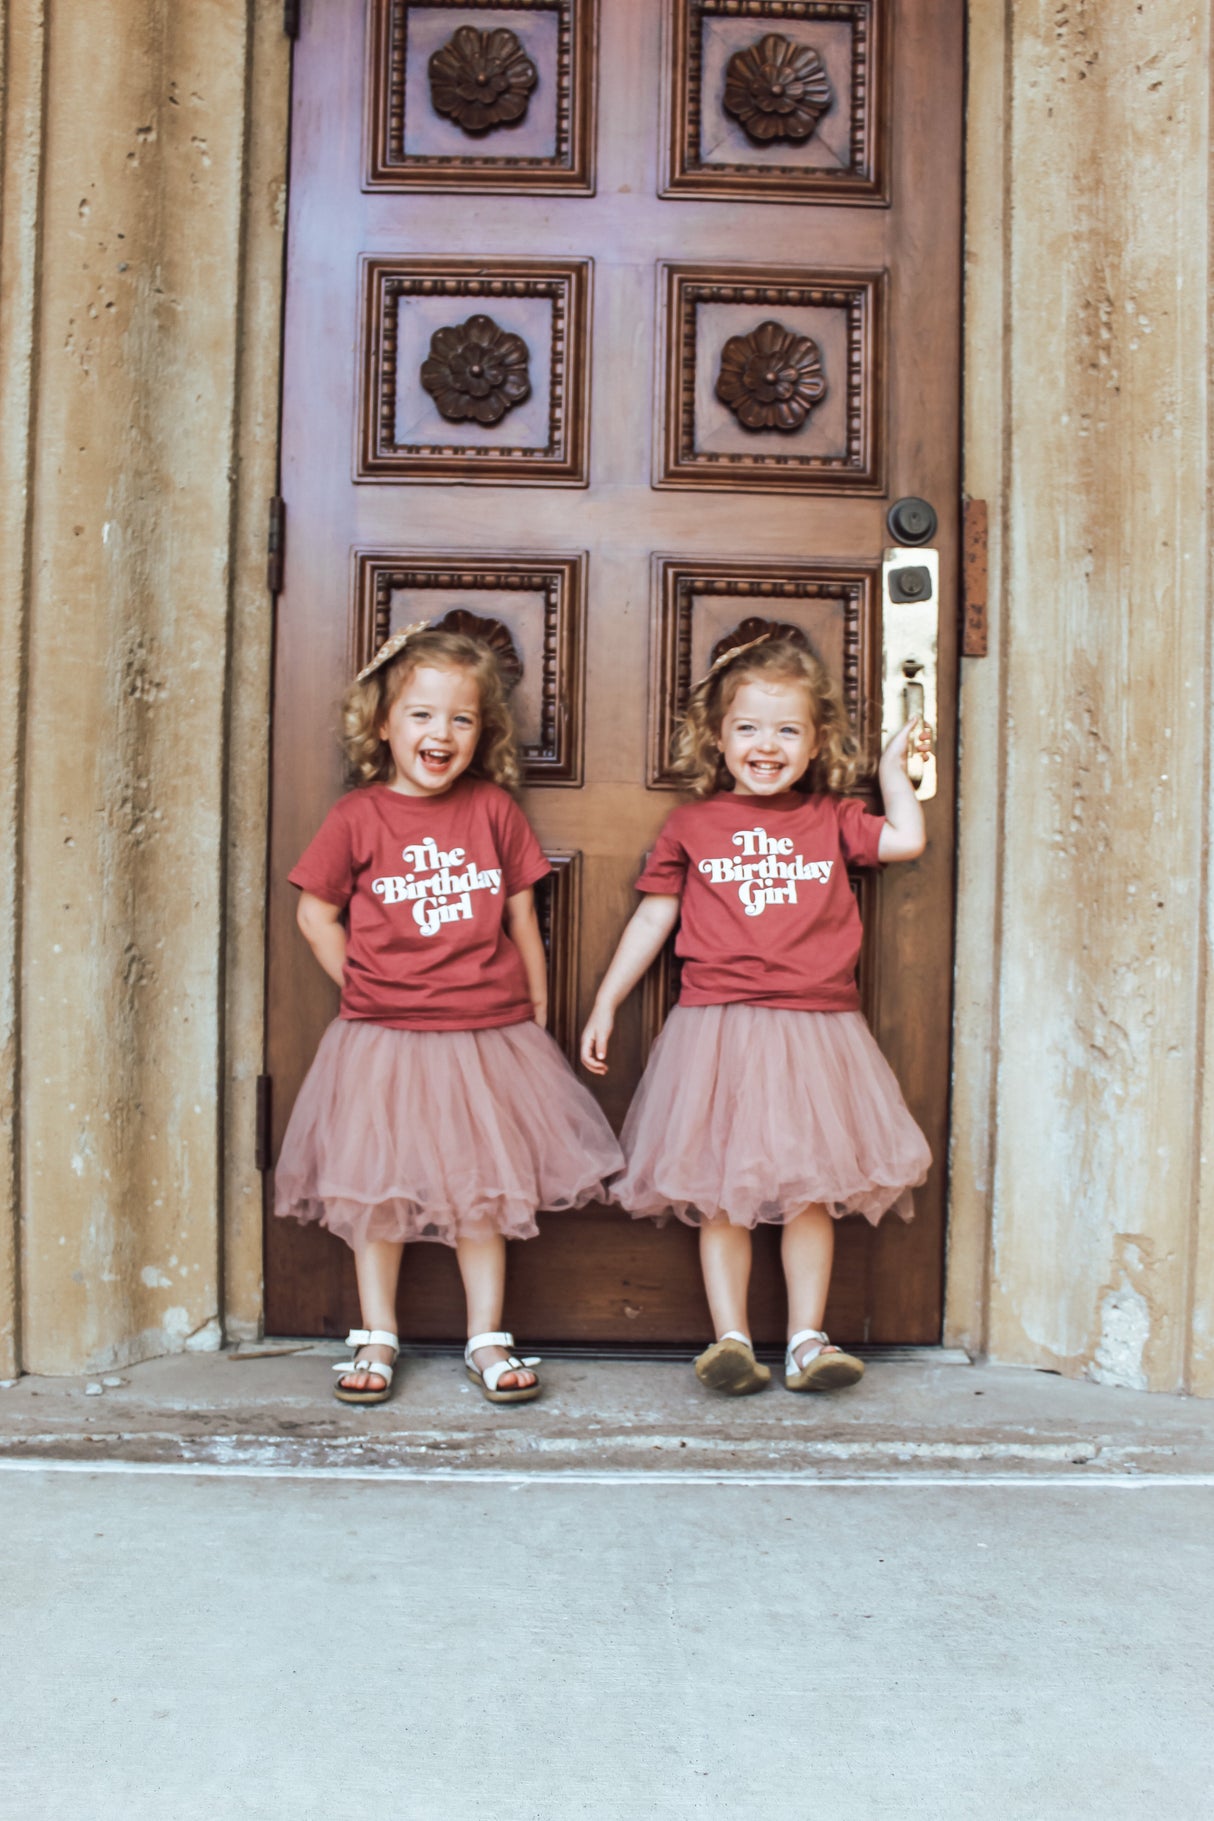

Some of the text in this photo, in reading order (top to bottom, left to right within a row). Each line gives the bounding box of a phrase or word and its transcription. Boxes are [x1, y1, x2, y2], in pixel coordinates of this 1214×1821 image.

[402, 837, 466, 872] The
[732, 827, 794, 856] The
[371, 862, 502, 904] Birthday
[698, 854, 834, 884] Birthday
[412, 892, 474, 937] Girl
[738, 878, 798, 917] Girl
